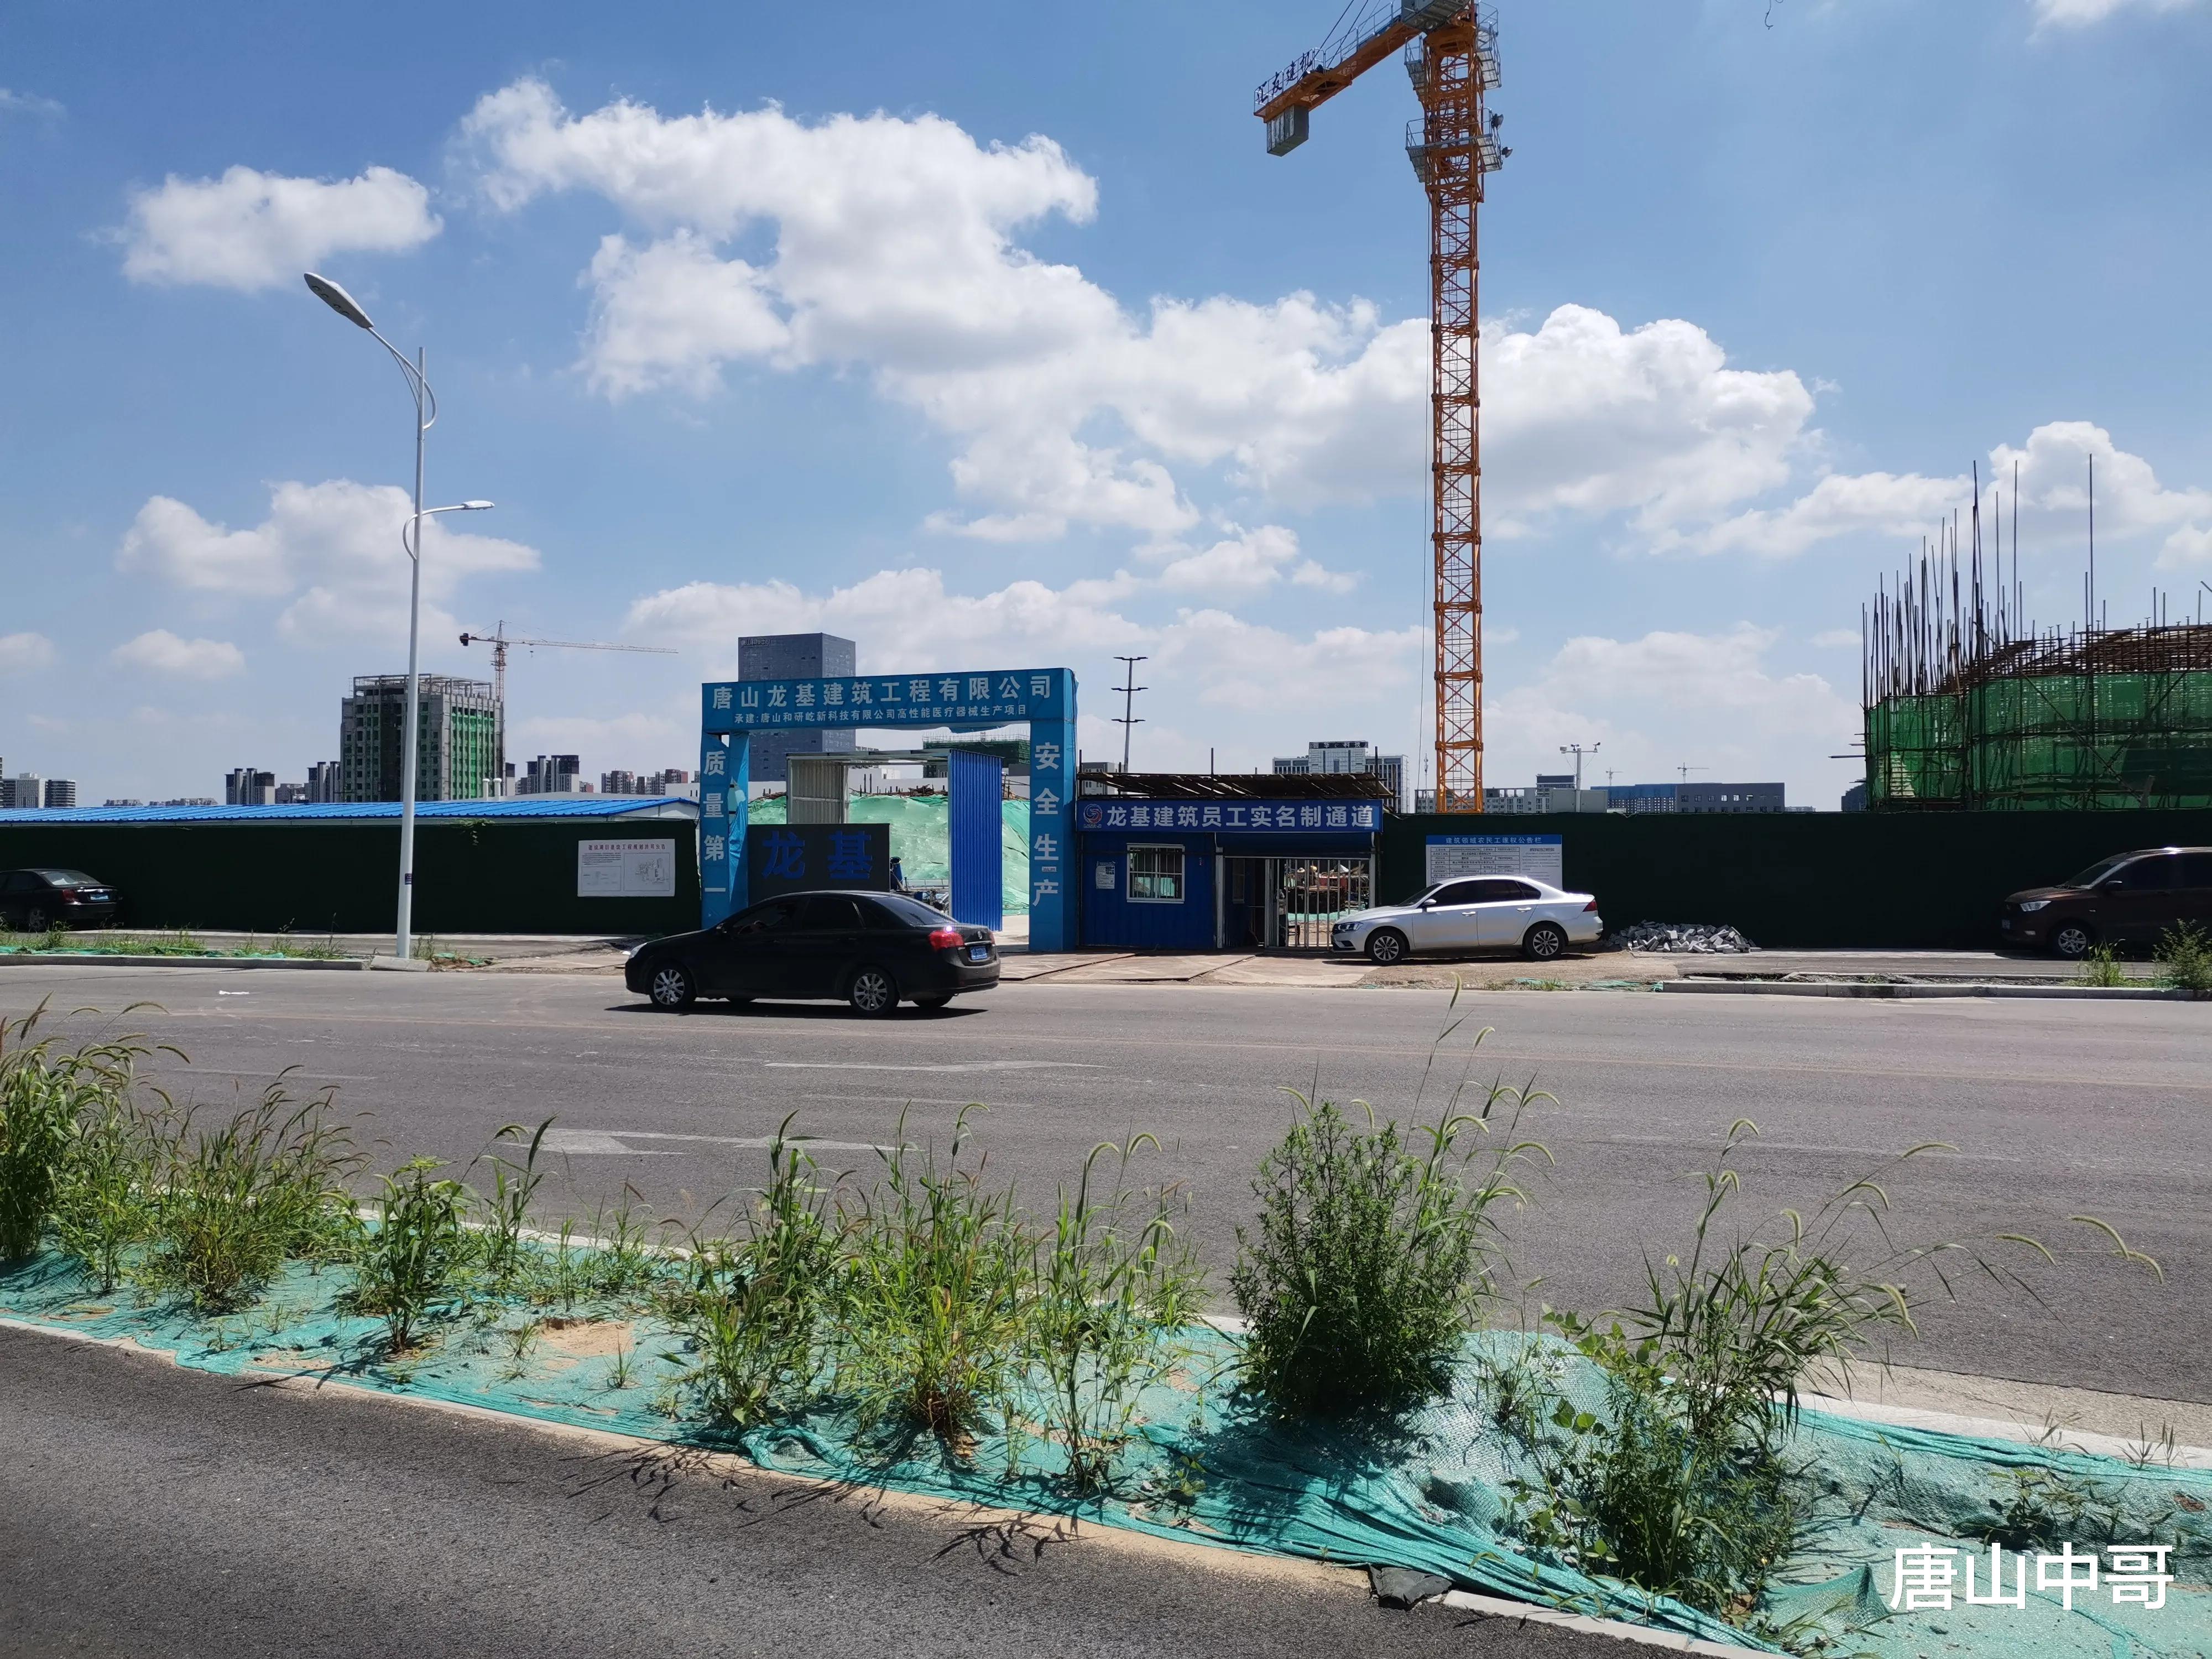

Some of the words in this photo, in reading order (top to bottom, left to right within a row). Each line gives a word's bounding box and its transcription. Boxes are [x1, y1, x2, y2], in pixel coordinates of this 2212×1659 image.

[712, 675, 1051, 710] 唐山龙基建筑工程有限公司
[703, 750, 726, 893] 质量第一
[1032, 742, 1061, 907] 安全生产
[1107, 805, 1374, 827] 龙基建筑员工实名制通道
[762, 830, 874, 880] 龙基
